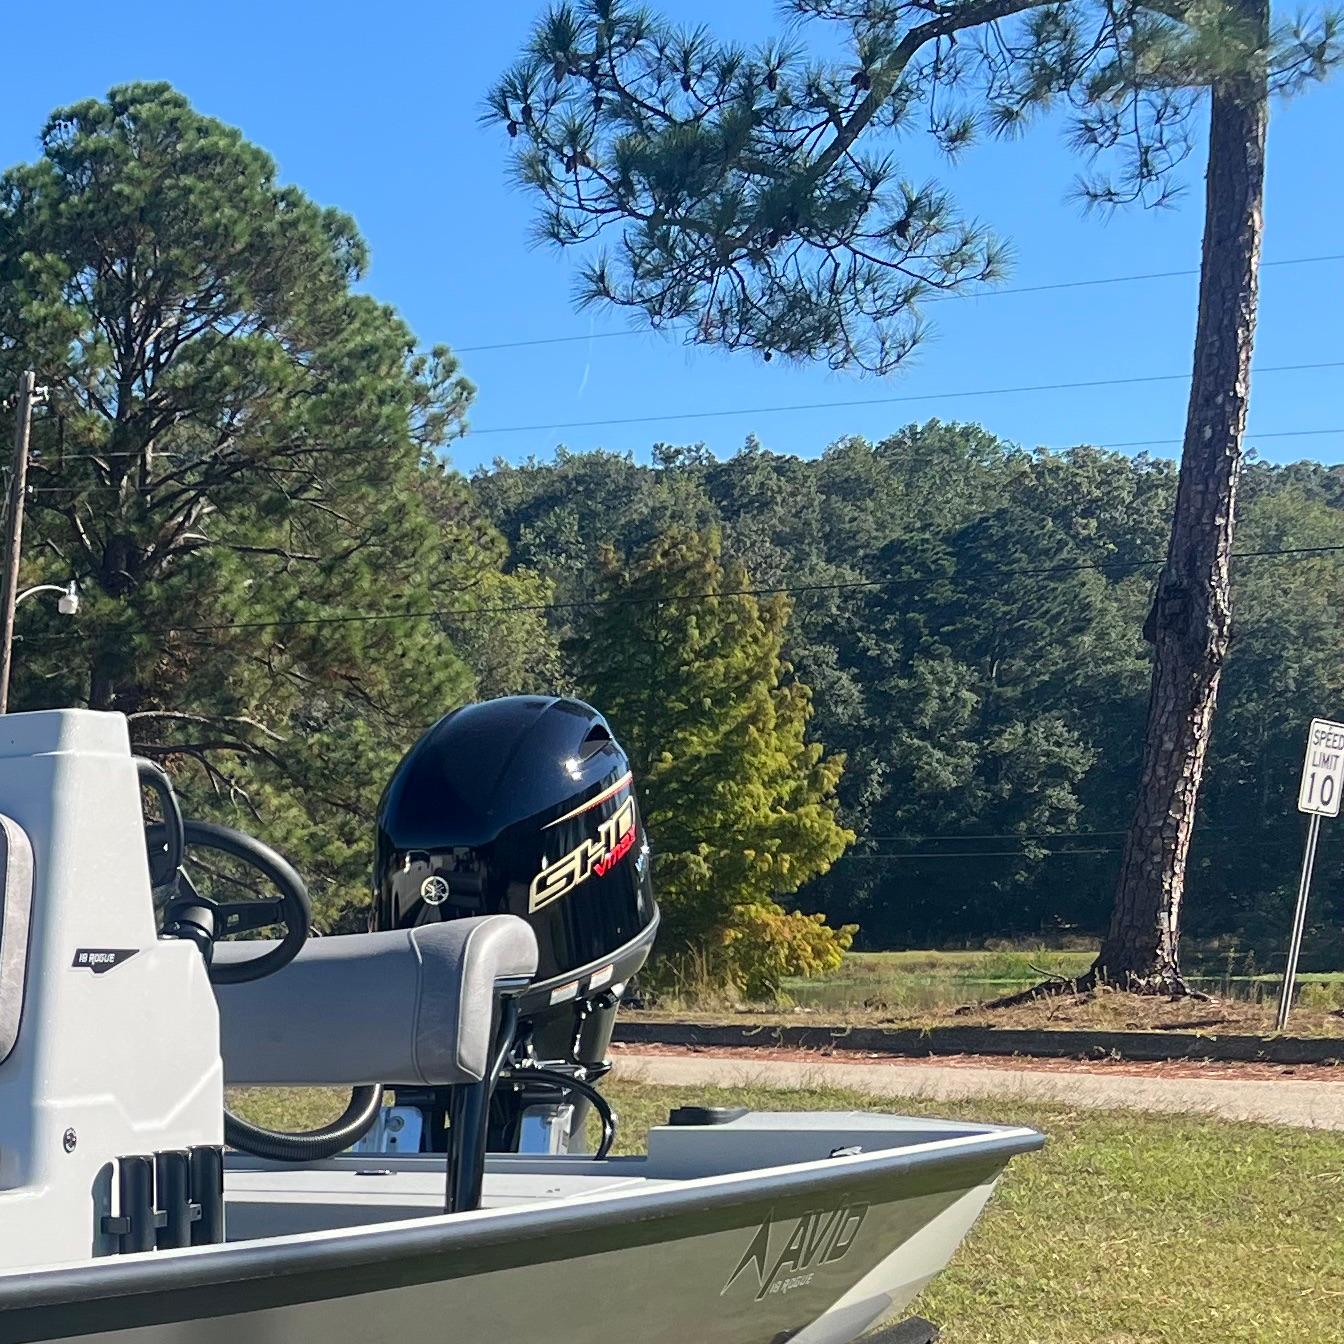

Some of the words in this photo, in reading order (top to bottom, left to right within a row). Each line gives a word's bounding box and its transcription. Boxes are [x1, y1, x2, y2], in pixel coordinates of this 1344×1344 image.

[1313, 729, 1344, 751] SPEED
[1312, 750, 1340, 771] LIMIT
[1308, 772, 1335, 806] 10
[88, 952, 116, 966] ROGUE
[753, 1194, 871, 1302] AVID
[782, 1273, 815, 1294] ROGUE
